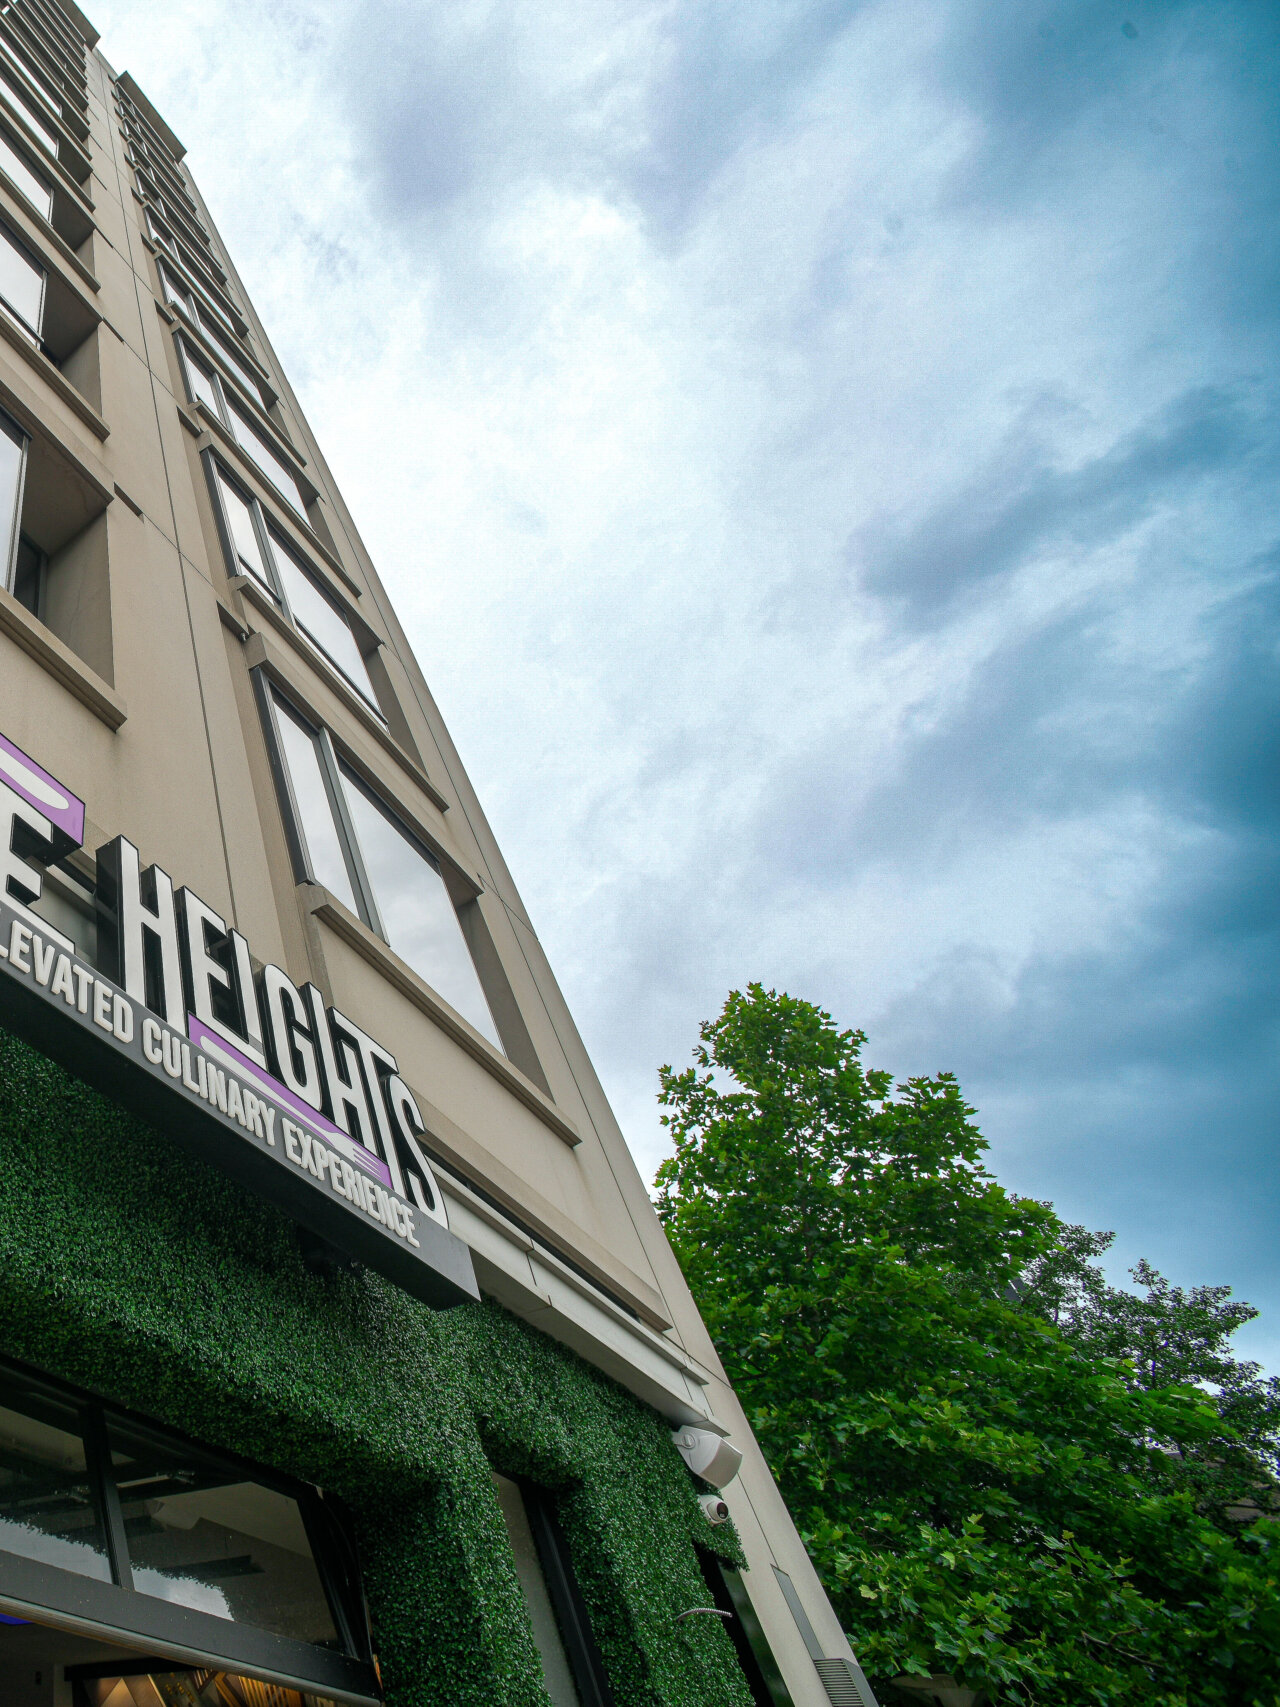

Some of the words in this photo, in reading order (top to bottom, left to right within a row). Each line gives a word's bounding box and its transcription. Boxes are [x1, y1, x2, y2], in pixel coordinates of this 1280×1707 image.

[120, 834, 449, 1231] HEIGHTS
[142, 1017, 277, 1147] CULINARY
[281, 1117, 421, 1249] EXPERIENCE
